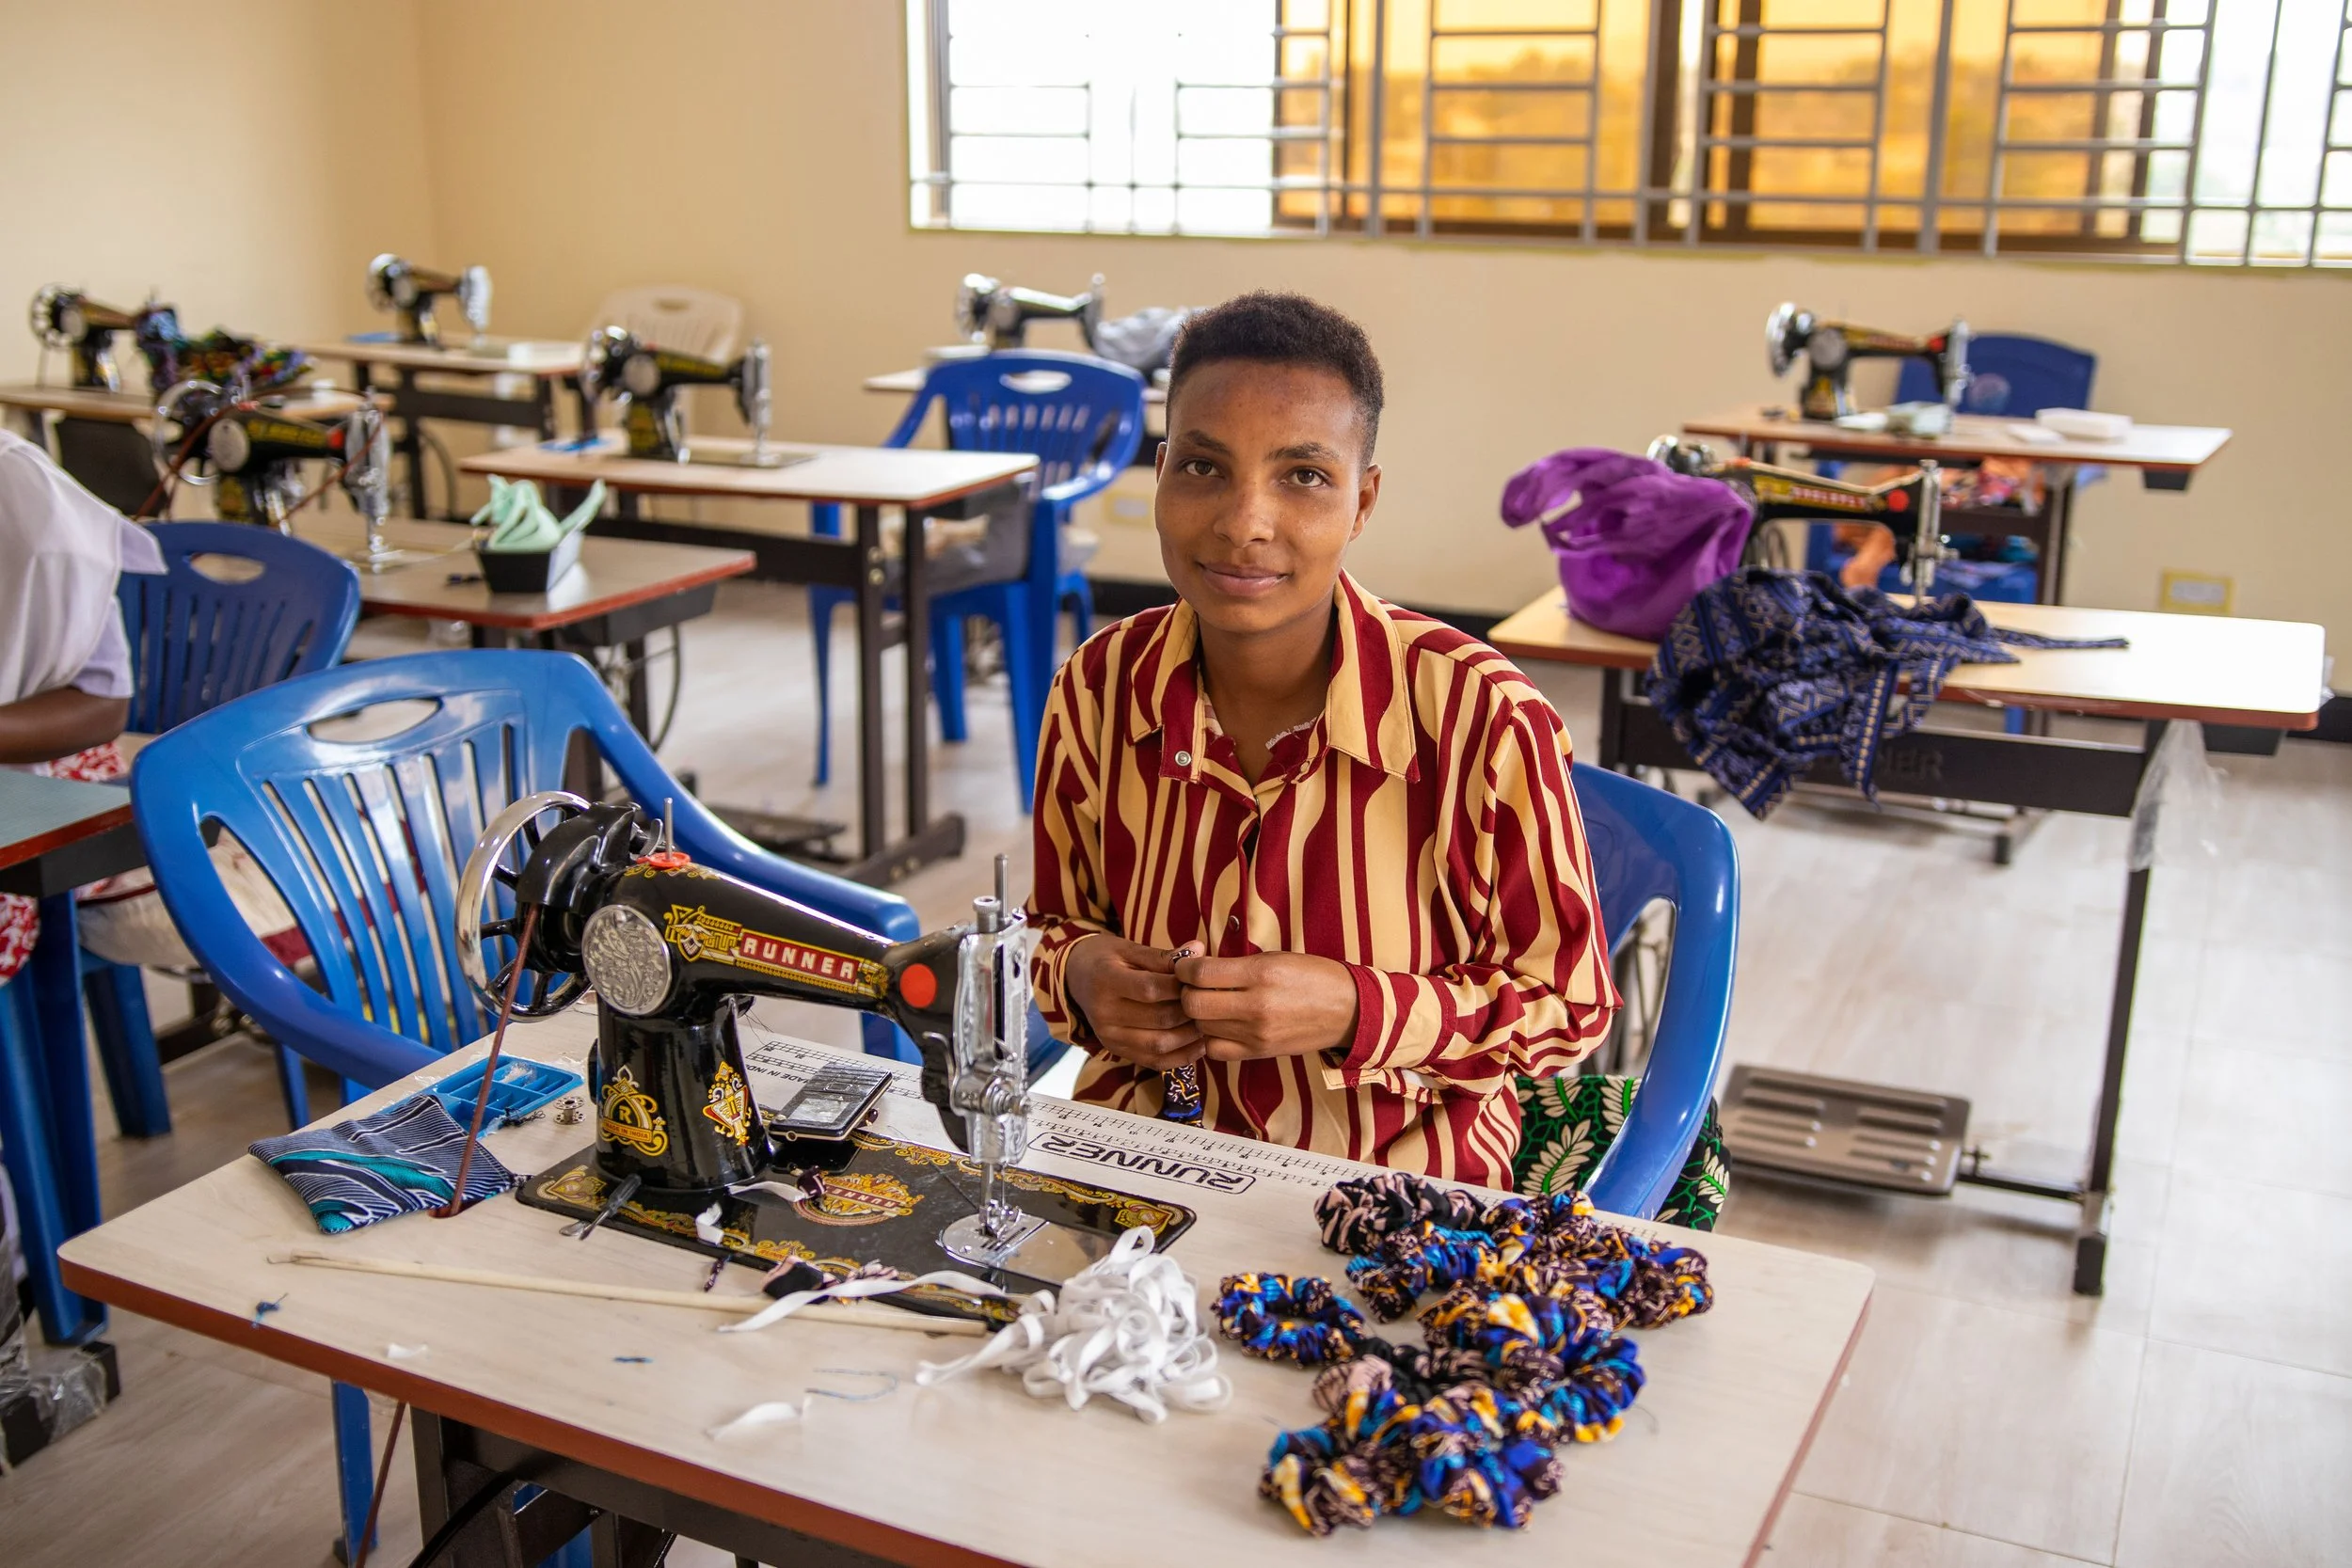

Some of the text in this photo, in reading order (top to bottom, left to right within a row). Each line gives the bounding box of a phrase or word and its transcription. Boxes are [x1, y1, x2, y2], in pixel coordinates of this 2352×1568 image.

[743, 938, 855, 979] RUNNER
[618, 1105, 632, 1124] R
[1041, 1134, 1245, 1191] RUNNER
[826, 1186, 897, 1208] RUNNE
